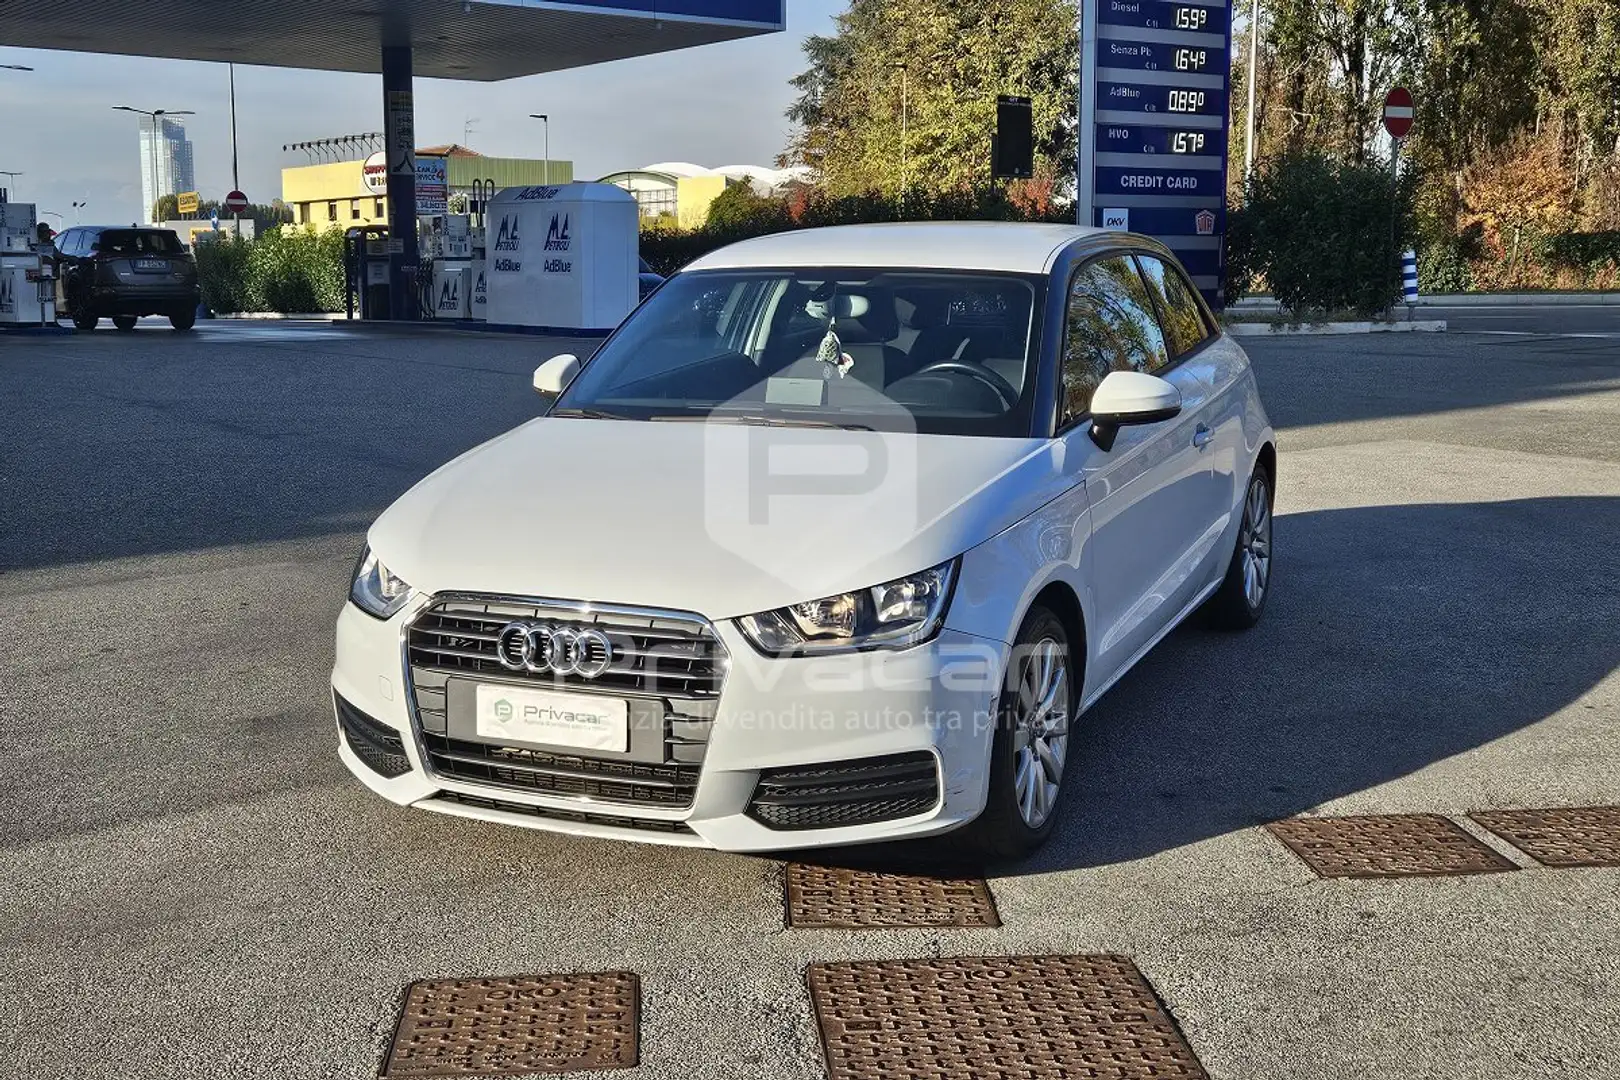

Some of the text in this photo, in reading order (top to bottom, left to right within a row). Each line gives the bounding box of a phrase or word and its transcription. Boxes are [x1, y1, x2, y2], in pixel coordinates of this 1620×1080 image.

[1111, 1, 1140, 13] Diesel
[1110, 43, 1153, 57] Senza Pb
[1109, 86, 1141, 99] AdBlue
[1108, 128, 1129, 140] HVO
[1120, 175, 1198, 189] CREDIT CARD
[514, 186, 561, 201] AdBlue
[1106, 217, 1126, 227] DKV
[494, 258, 521, 272] AdBlue
[543, 258, 573, 273] AdBlue
[523, 705, 610, 725] Privacar
